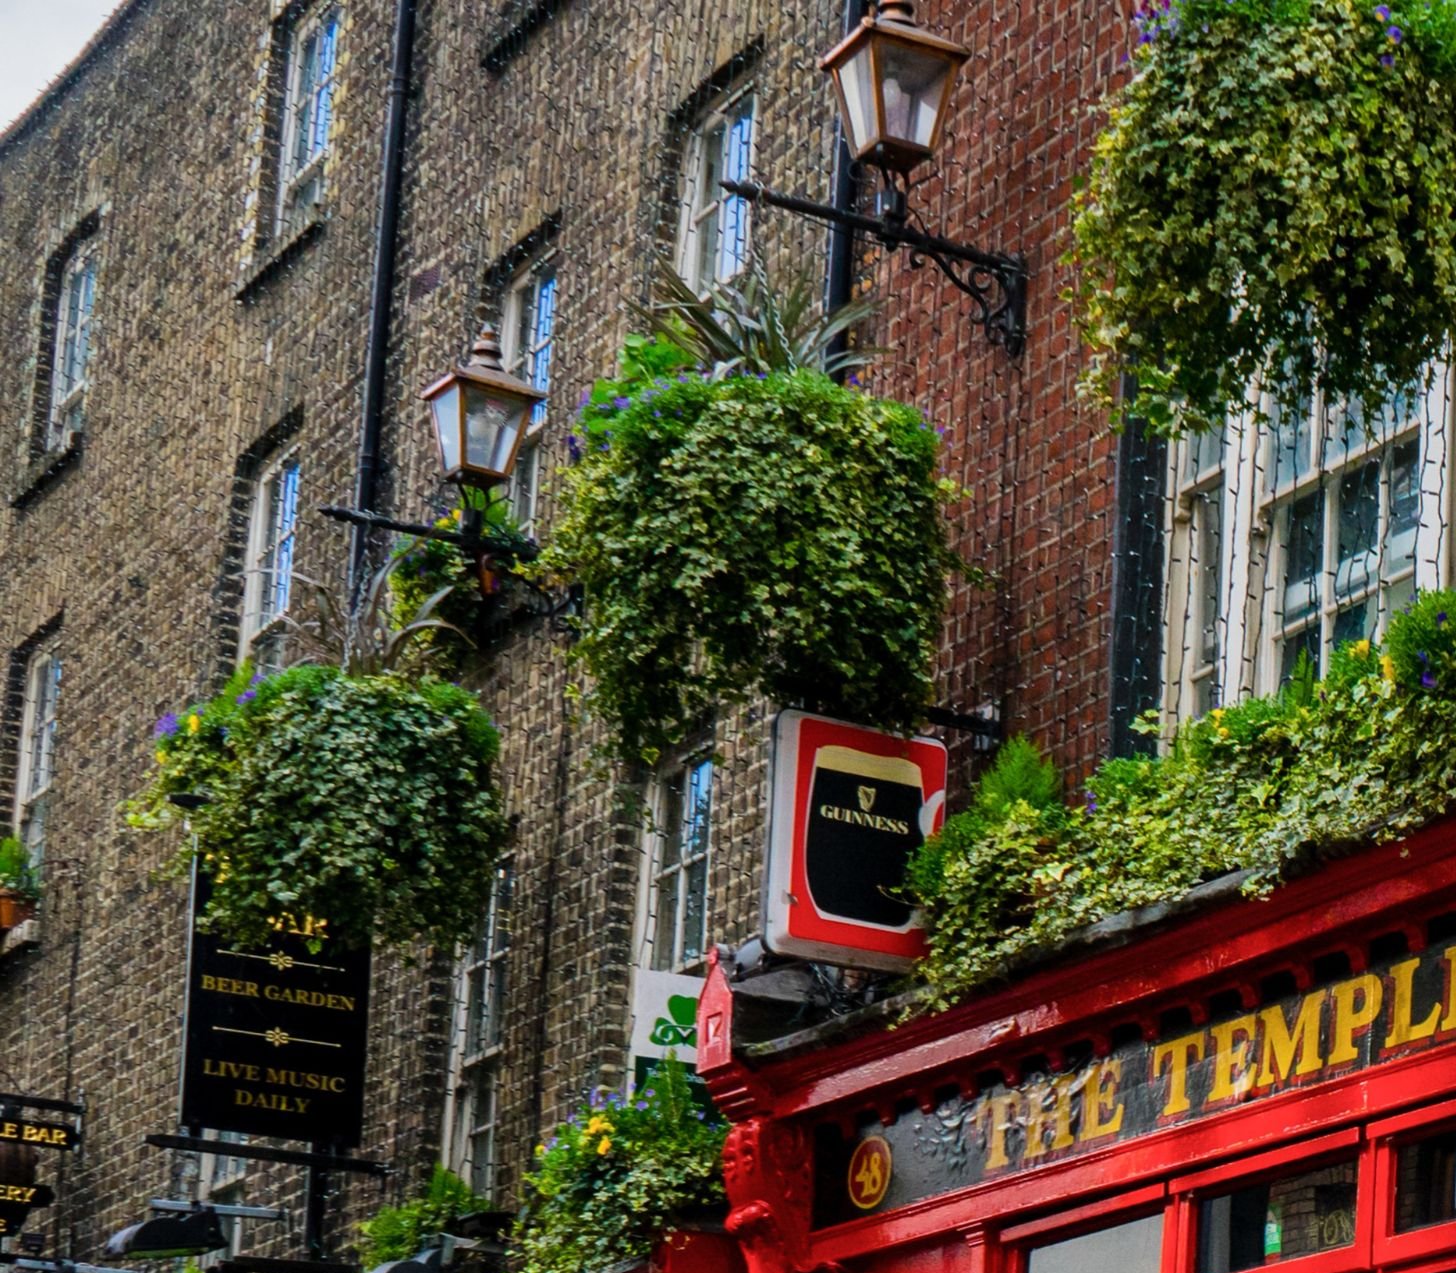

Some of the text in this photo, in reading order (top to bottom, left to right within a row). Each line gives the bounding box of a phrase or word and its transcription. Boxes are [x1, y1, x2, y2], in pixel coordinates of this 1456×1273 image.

[820, 804, 909, 835] GUINNESS
[201, 975, 355, 1011] BEER GARDEN
[203, 1059, 346, 1093] LIVE MUSIC
[235, 1089, 311, 1114] DAILY
[980, 1062, 1123, 1170] THE
[22, 1124, 68, 1145] BAR
[859, 1149, 884, 1199] 48
